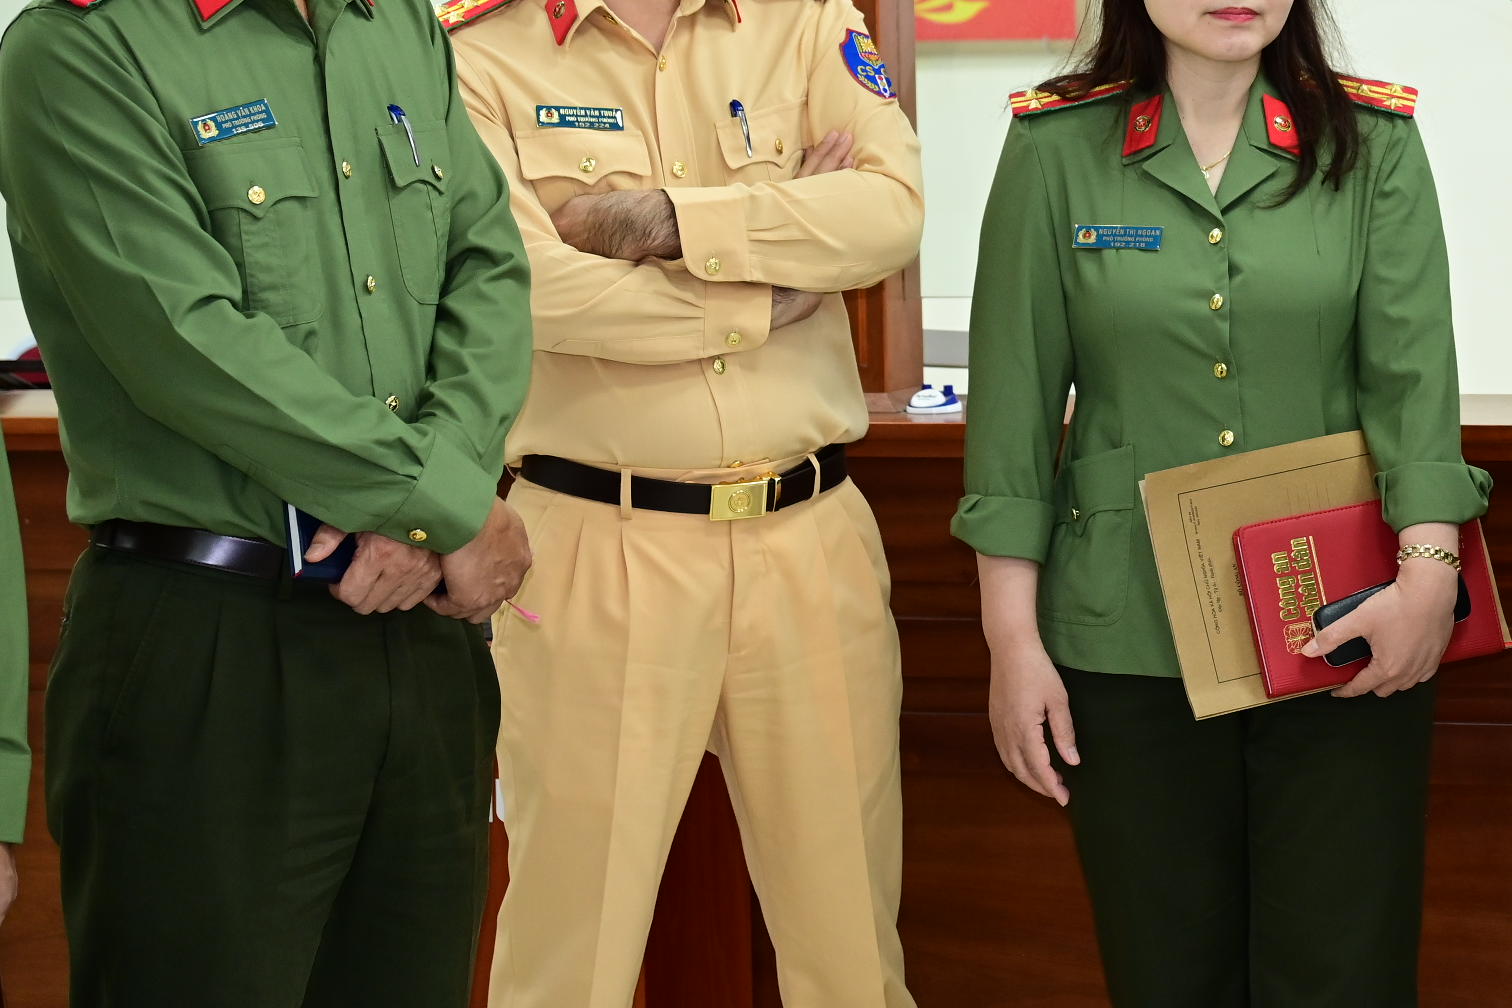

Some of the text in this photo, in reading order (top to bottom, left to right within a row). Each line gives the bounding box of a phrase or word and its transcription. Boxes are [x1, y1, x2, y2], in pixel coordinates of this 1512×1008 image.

[857, 66, 875, 76] CS
[1271, 550, 1300, 621] Công an
[1290, 537, 1321, 617] nhân dân
